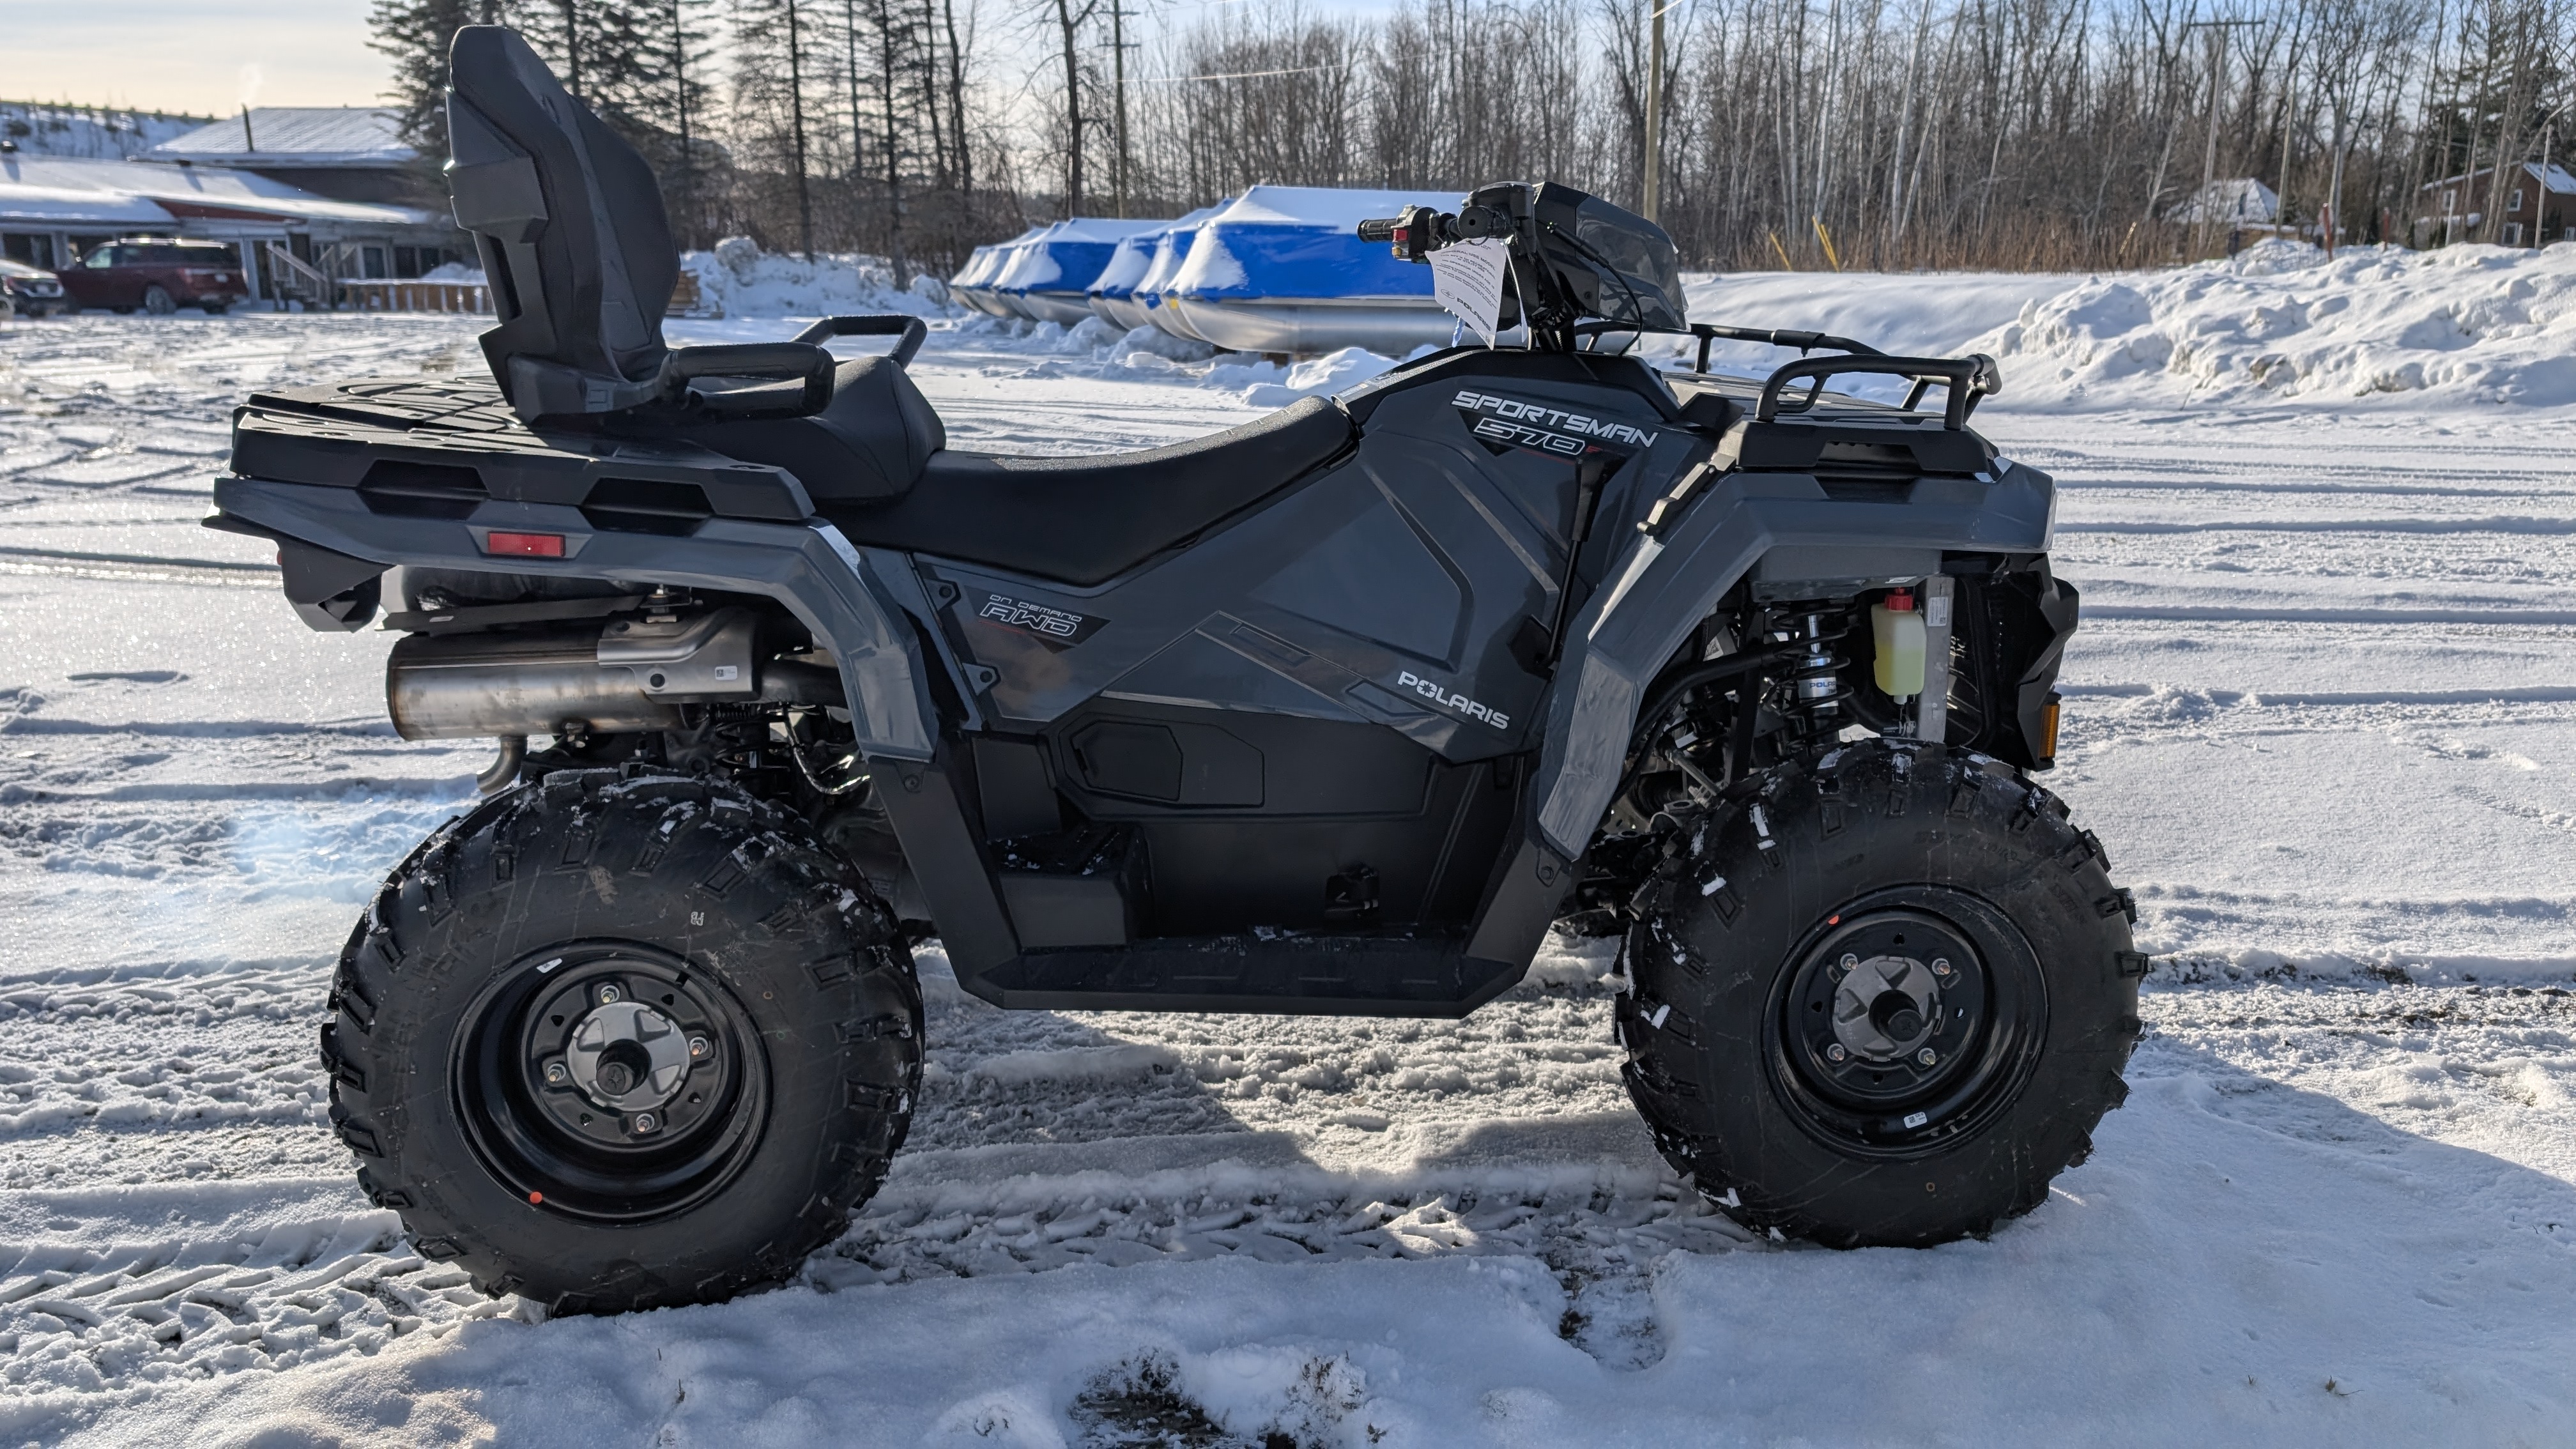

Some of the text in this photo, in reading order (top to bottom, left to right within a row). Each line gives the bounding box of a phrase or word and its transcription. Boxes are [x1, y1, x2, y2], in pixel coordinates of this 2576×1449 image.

[1457, 297, 1491, 331] POLARIS
[1452, 390, 1659, 447] SPORTSMAN
[1473, 417, 1585, 456] 570
[979, 602, 1077, 636] AWD
[1018, 601, 1082, 622] DEMAND
[1397, 671, 1510, 730] POLARIS
